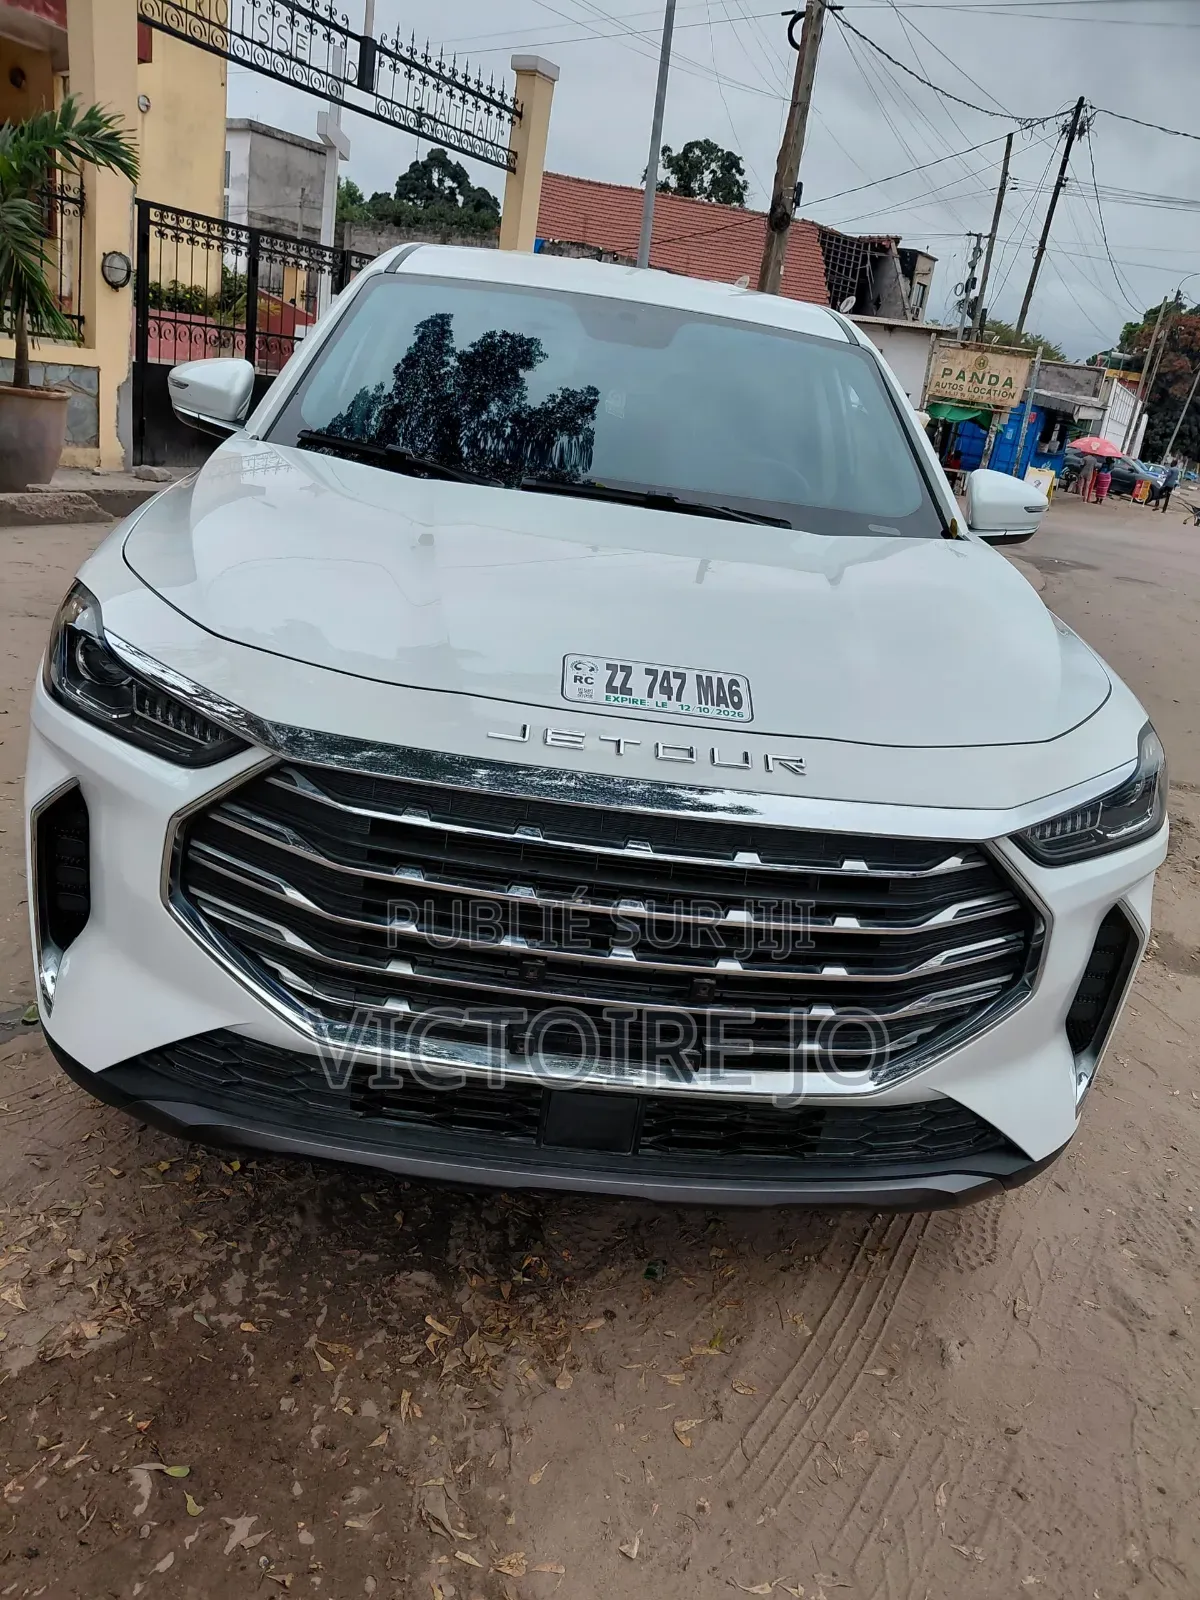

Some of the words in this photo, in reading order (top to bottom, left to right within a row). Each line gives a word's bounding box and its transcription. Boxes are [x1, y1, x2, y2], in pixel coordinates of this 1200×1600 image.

[413, 86, 500, 142] PLATEAU
[941, 367, 1013, 389] PANDA
[934, 381, 965, 392] AUTOS
[967, 385, 1016, 400] LOCATION
[573, 674, 595, 685] RC
[605, 662, 633, 697] ZZ
[644, 667, 687, 703] 747
[695, 674, 743, 711] MA6
[655, 701, 668, 709] LE
[678, 703, 745, 719] 12/10/2026
[486, 723, 807, 776] JETOUR
